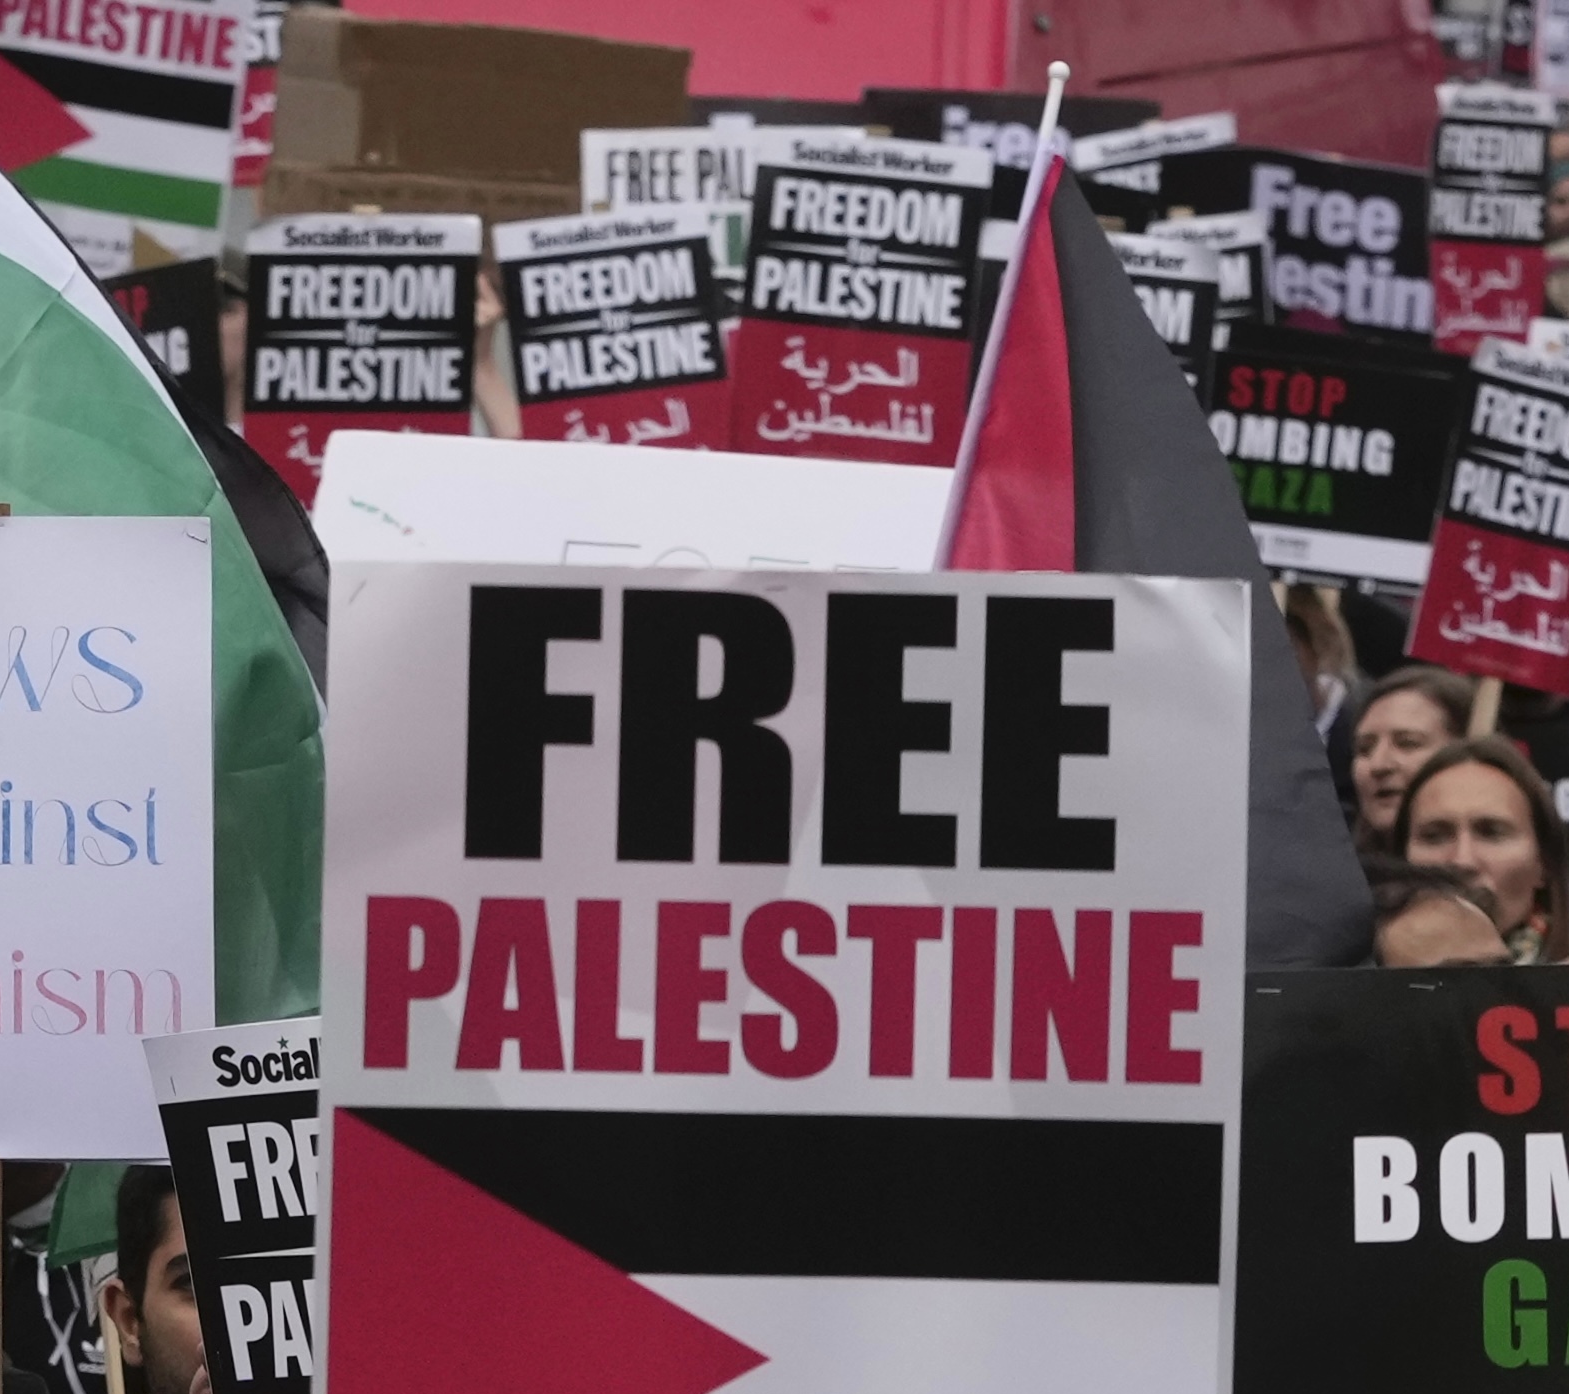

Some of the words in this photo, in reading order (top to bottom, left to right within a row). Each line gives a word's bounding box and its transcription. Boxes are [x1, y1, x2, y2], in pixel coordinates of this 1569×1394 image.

[606, 149, 681, 202] FREE
[792, 141, 877, 171] Socialist
[885, 149, 955, 176] Worker
[284, 224, 373, 249] Socialist
[380, 223, 446, 247] Worker
[770, 176, 960, 247] FREEDOM
[1249, 164, 1402, 253] Free
[267, 263, 455, 320] FREEDOM
[518, 247, 695, 320] FREEDOM
[752, 257, 966, 329] PALESTINE
[255, 347, 463, 404] PALESTINE
[521, 322, 716, 395] PALESTINE
[781, 336, 919, 395] الحرية
[756, 395, 934, 443] لفلسطين
[1228, 366, 1346, 413] STOP
[1462, 538, 1569, 601] الحرية
[464, 584, 1116, 872] FREE
[363, 894, 1204, 1085] PALESTINE
